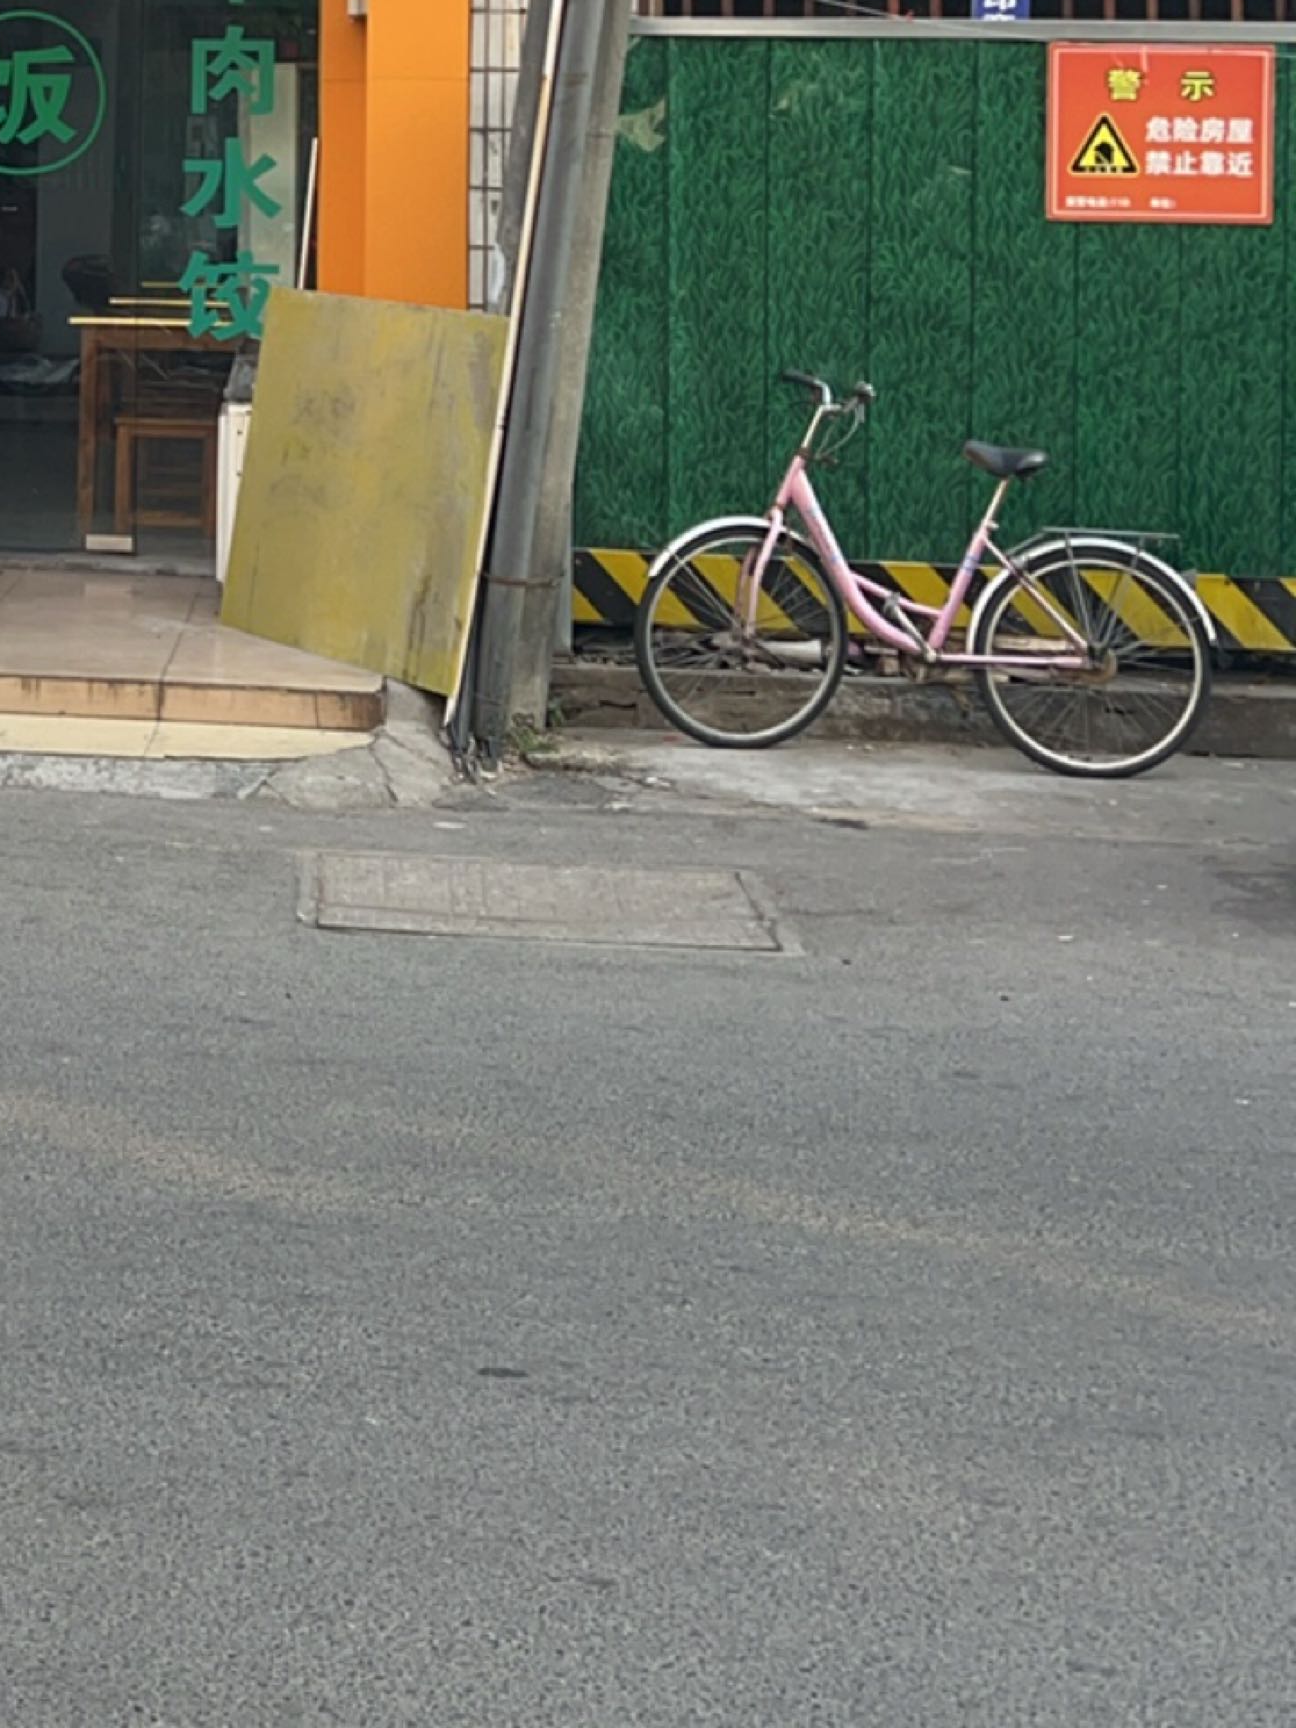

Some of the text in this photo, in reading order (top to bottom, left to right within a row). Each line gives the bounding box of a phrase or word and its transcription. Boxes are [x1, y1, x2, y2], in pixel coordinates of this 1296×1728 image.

[1108, 69, 1216, 102] 警示
[1145, 116, 1254, 144] 危险房屋
[1145, 151, 1254, 177] 禁止靠近
